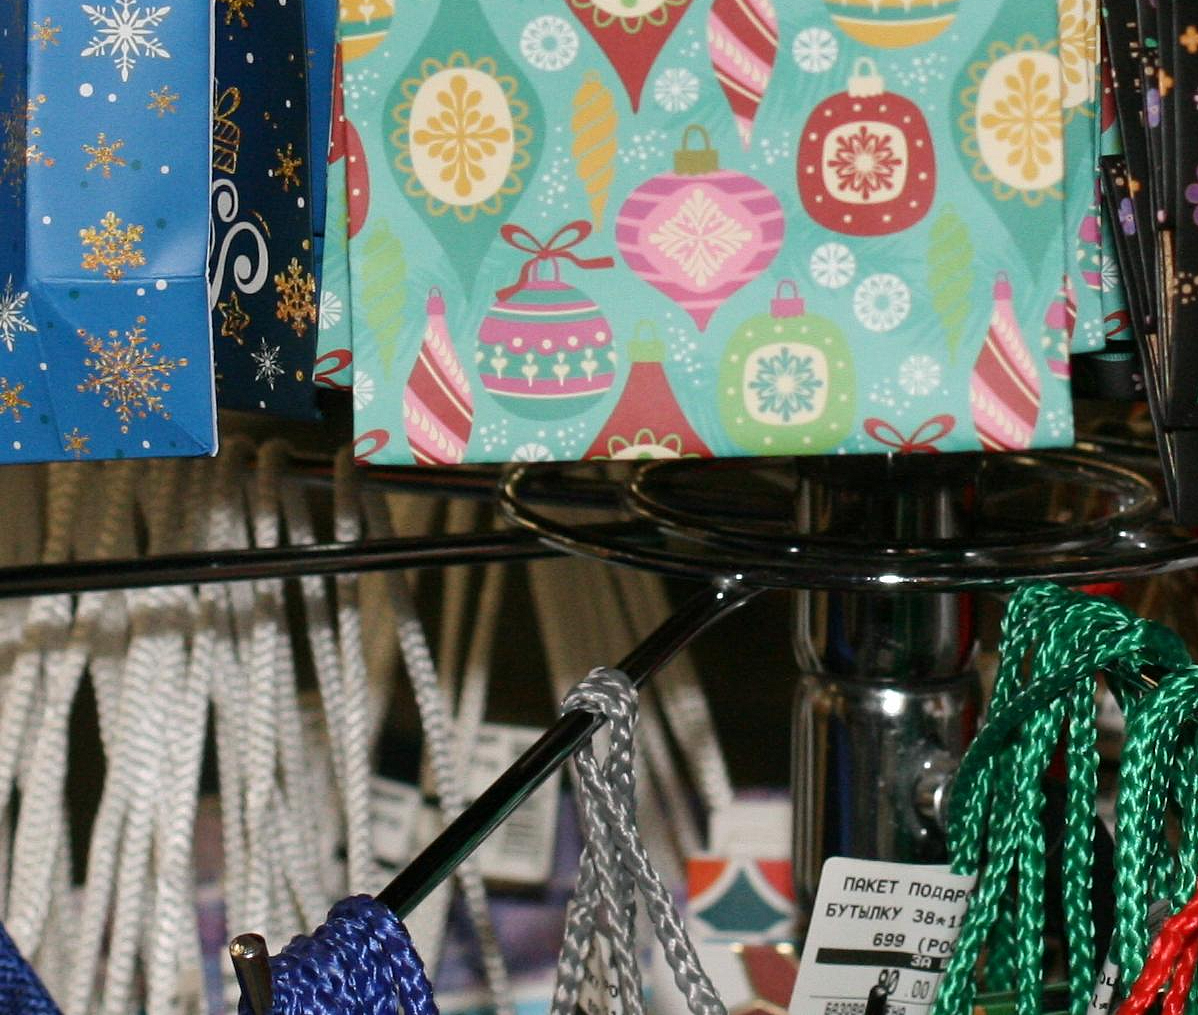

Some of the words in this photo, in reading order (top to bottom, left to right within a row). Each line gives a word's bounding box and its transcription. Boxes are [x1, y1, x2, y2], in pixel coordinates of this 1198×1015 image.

[843, 876, 899, 895] ПАКЕТ
[825, 902, 903, 921] БУТЫЛКУ
[872, 932, 906, 948] 699
[910, 954, 933, 969] ЗА
